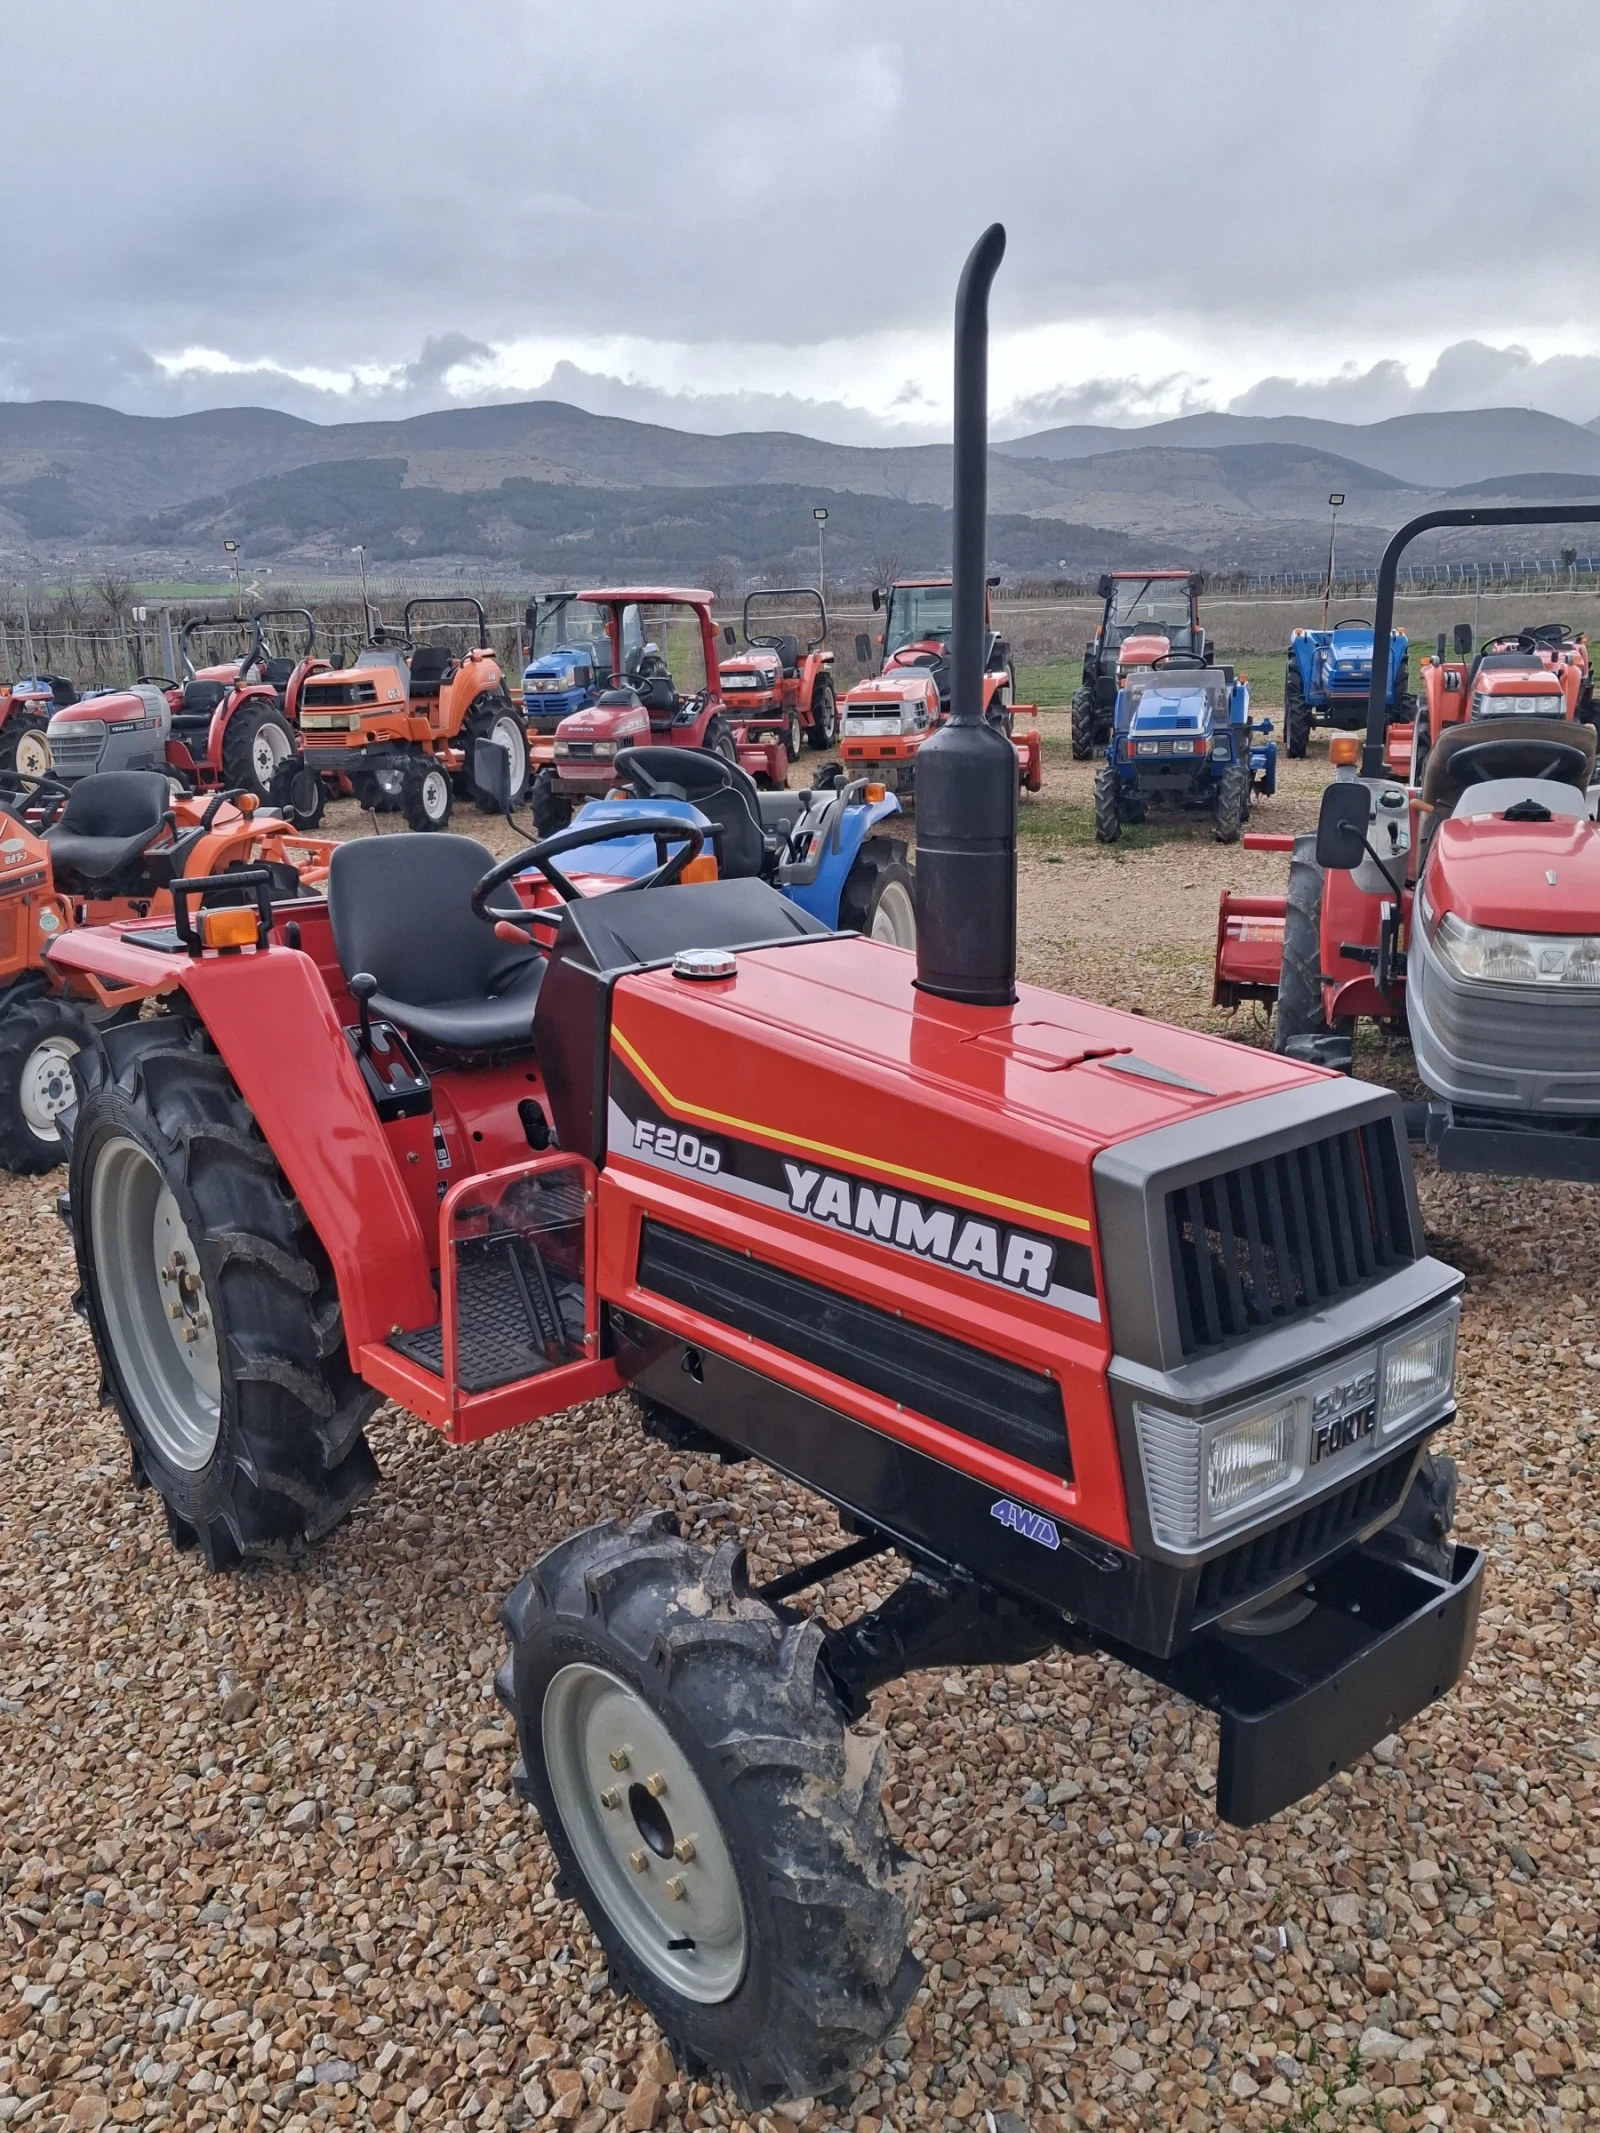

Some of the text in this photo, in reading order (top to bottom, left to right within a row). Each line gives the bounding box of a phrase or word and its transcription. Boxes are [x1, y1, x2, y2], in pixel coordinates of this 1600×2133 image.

[633, 1118, 722, 1174] F20D
[783, 1160, 1055, 1295] YANMAR
[1310, 1399, 1376, 1465] FORTE
[990, 1499, 1060, 1550] 4WD
